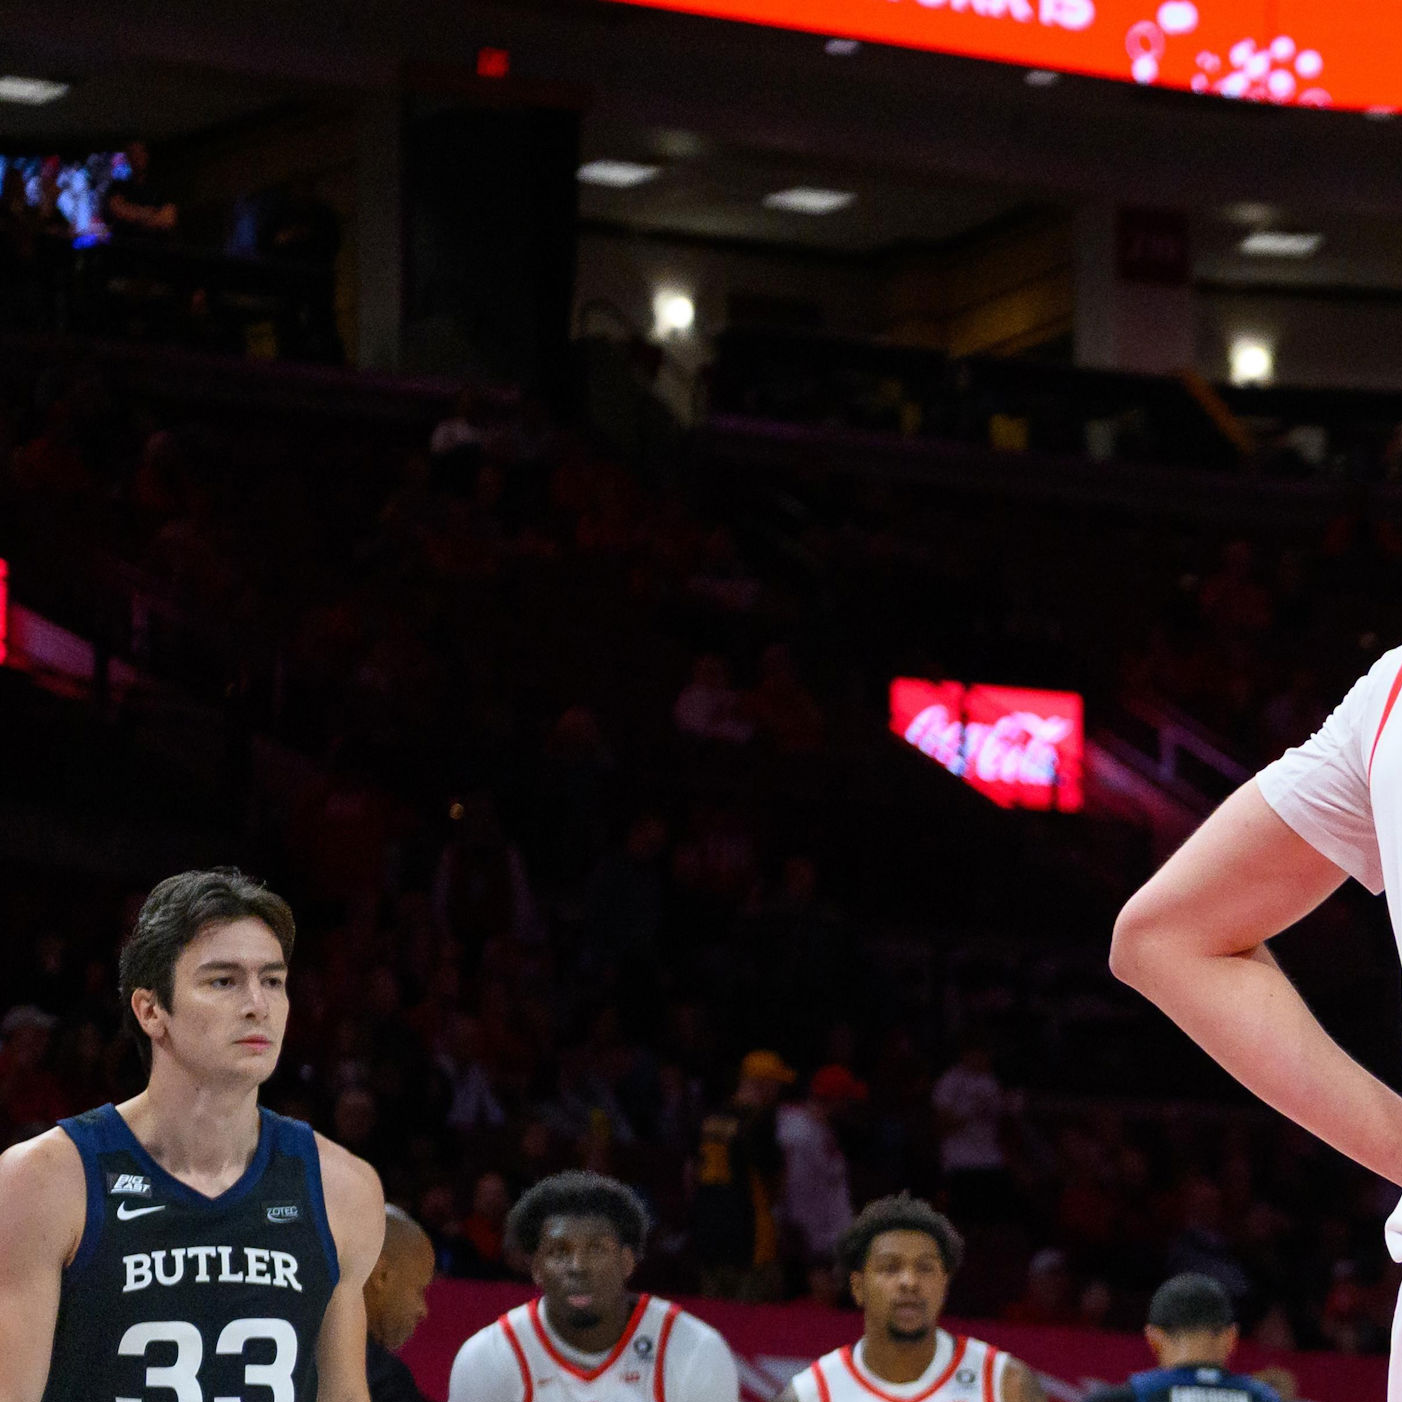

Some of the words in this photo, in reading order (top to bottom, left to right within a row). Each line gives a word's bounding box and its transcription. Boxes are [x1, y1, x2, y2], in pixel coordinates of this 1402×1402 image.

[116, 1173, 146, 1184] BIG
[111, 1182, 151, 1193] EAST
[122, 1245, 303, 1293] BUTLER
